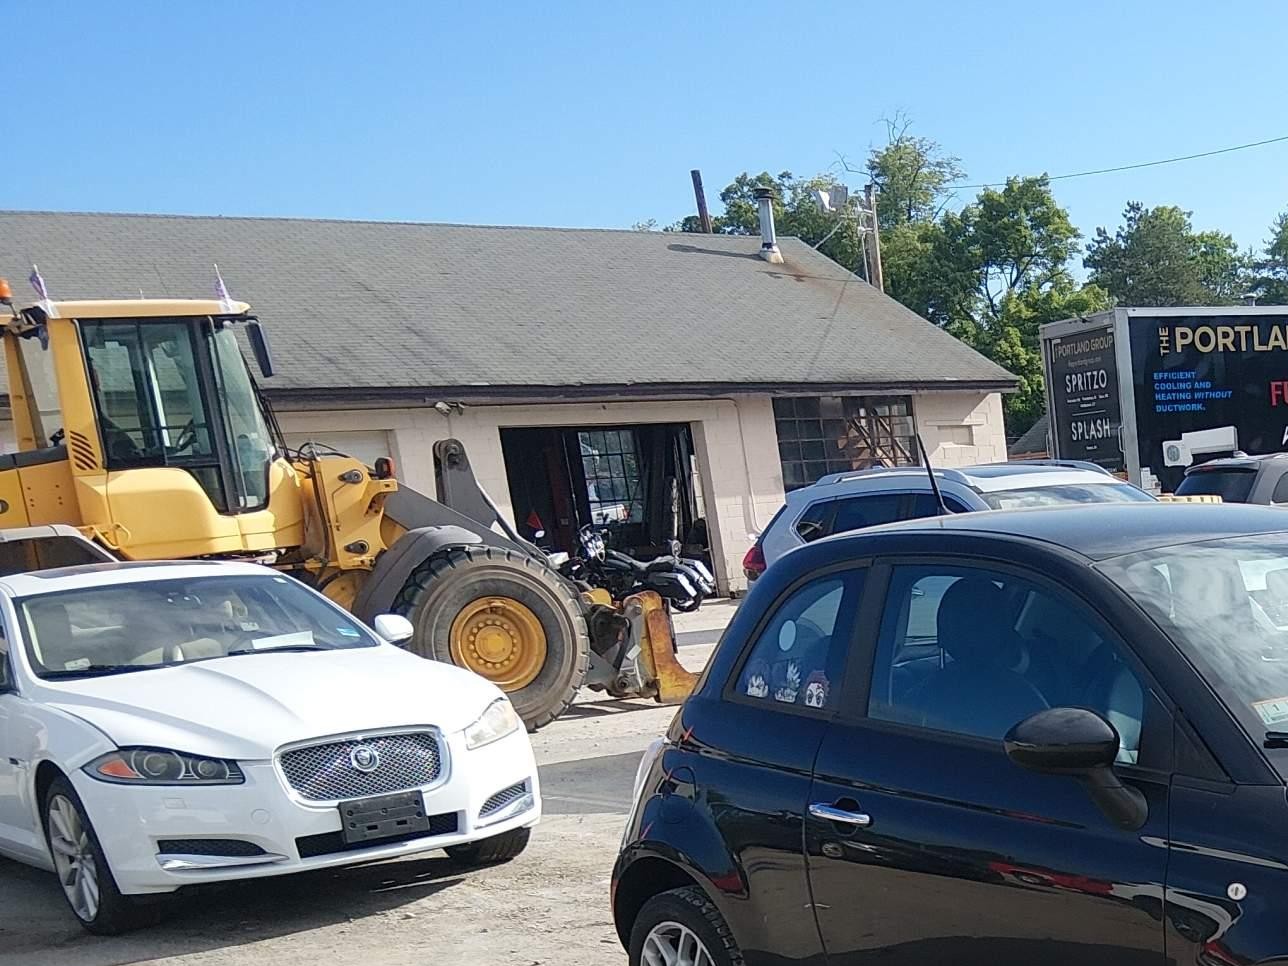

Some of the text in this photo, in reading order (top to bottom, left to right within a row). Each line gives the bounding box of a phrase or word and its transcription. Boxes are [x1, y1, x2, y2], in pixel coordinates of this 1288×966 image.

[1058, 340, 1090, 358] PORTLAND
[1090, 335, 1114, 351] GROUP
[1159, 327, 1169, 355] THE
[1065, 369, 1107, 393] SPRITZO
[1153, 371, 1197, 380] EFFICIENT
[1154, 381, 1212, 390] COOLING AND
[1155, 391, 1233, 401] HEATING WITHOUT
[1156, 403, 1206, 412] DUCTWORK.
[1071, 418, 1111, 441] SPLASH
